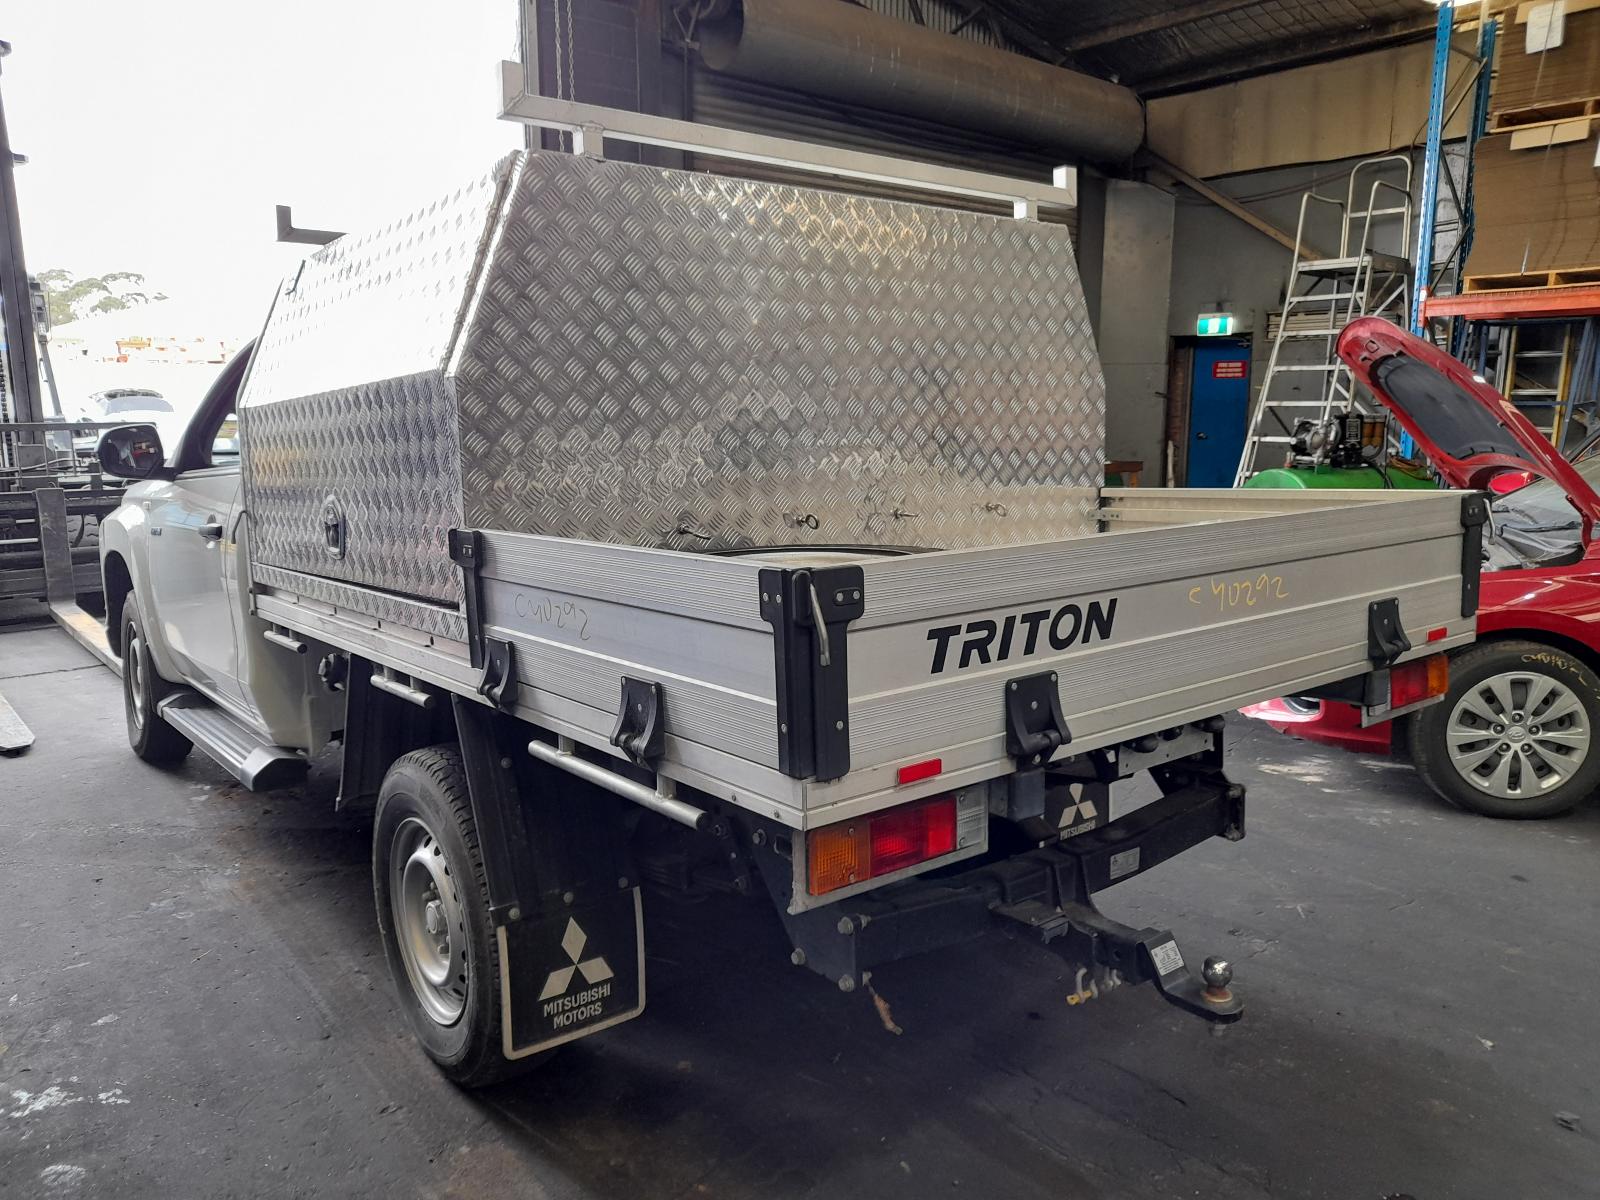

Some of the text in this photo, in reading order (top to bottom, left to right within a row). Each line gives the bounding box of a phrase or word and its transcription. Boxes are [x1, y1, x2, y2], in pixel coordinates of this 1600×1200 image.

[927, 598, 1118, 675] TRITON
[543, 984, 612, 1018] MITSUBISHI
[553, 1002, 603, 1030] MOTORS
